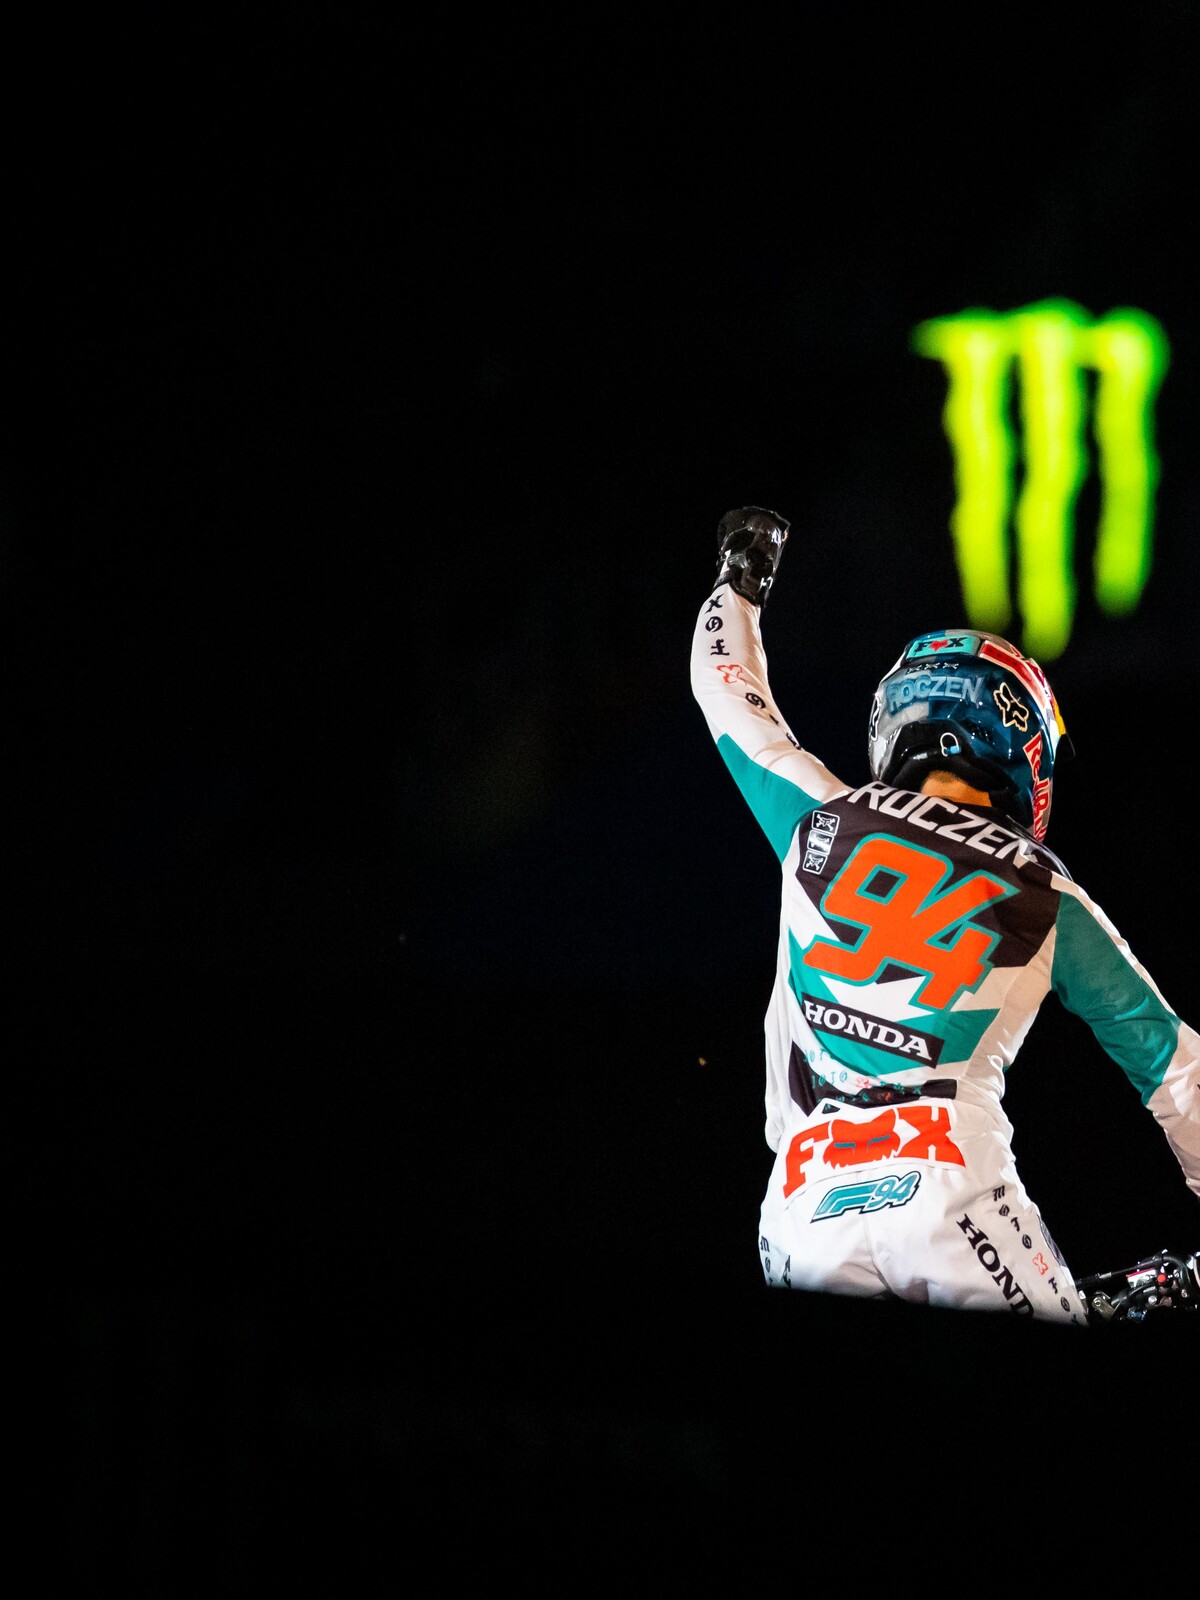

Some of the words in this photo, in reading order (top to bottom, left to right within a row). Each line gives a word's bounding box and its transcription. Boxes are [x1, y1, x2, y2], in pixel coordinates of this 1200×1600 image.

[886, 675, 984, 717] ROCZEN
[801, 832, 1021, 1012] 94
[803, 1000, 932, 1061] HONDA
[956, 1213, 1035, 1317] HOND
